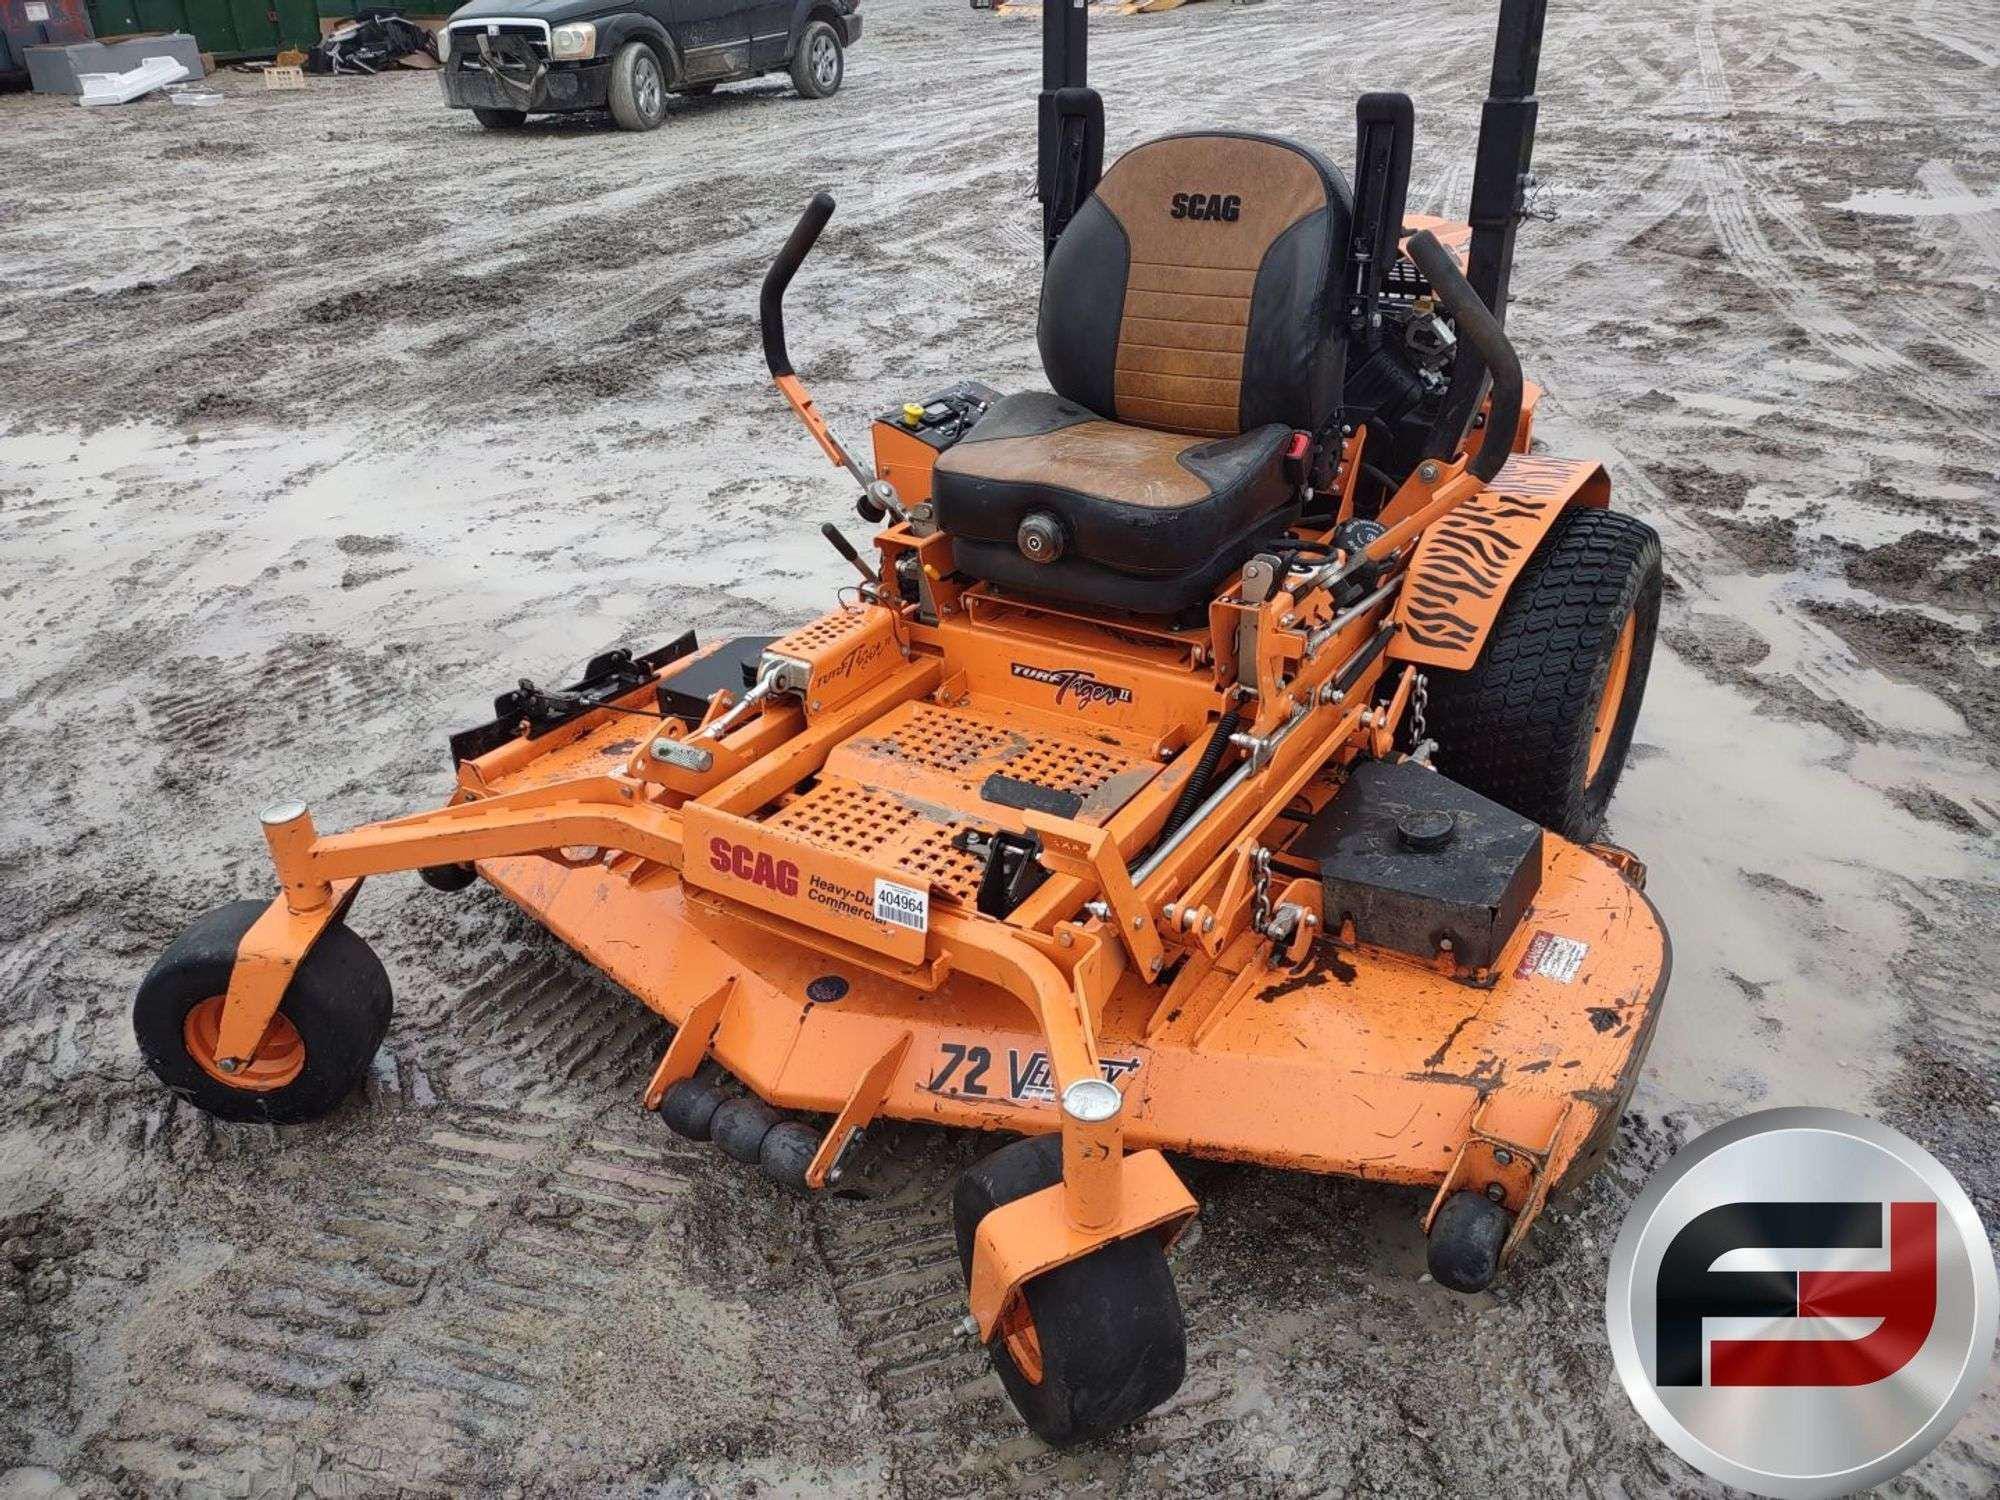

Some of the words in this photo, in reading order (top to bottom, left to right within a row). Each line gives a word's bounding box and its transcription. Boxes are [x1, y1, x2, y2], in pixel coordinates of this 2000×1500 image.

[1170, 193, 1241, 222] SCAG
[1051, 669, 1116, 710] Tiger
[709, 836, 799, 897] SCAG
[809, 874, 874, 906] Heavy-Du
[878, 889, 924, 914] 404964
